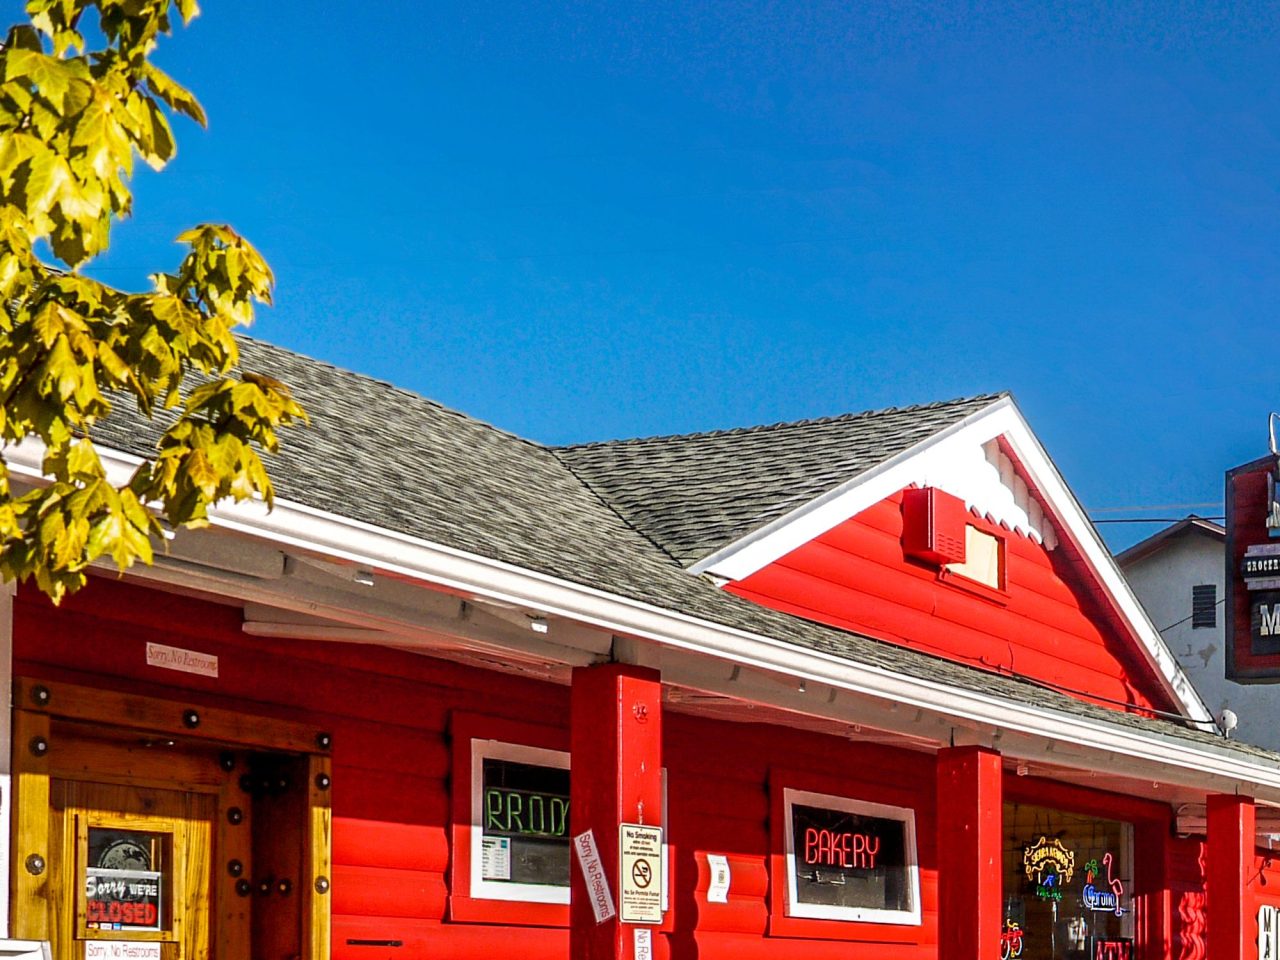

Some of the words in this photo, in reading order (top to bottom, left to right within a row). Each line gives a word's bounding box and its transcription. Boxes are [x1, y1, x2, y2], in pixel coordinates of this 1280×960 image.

[626, 830, 634, 838] No
[634, 831, 657, 842] Smoking
[804, 827, 881, 869] BAKERY
[86, 876, 127, 899] Sorry
[129, 884, 158, 897] WE'RE
[590, 872, 611, 919] Restrooms
[1083, 884, 1116, 909] Corona
[86, 899, 158, 926] CLOSED
[637, 930, 649, 943] No
[110, 944, 121, 957] No
[122, 945, 159, 958] Restrooms
